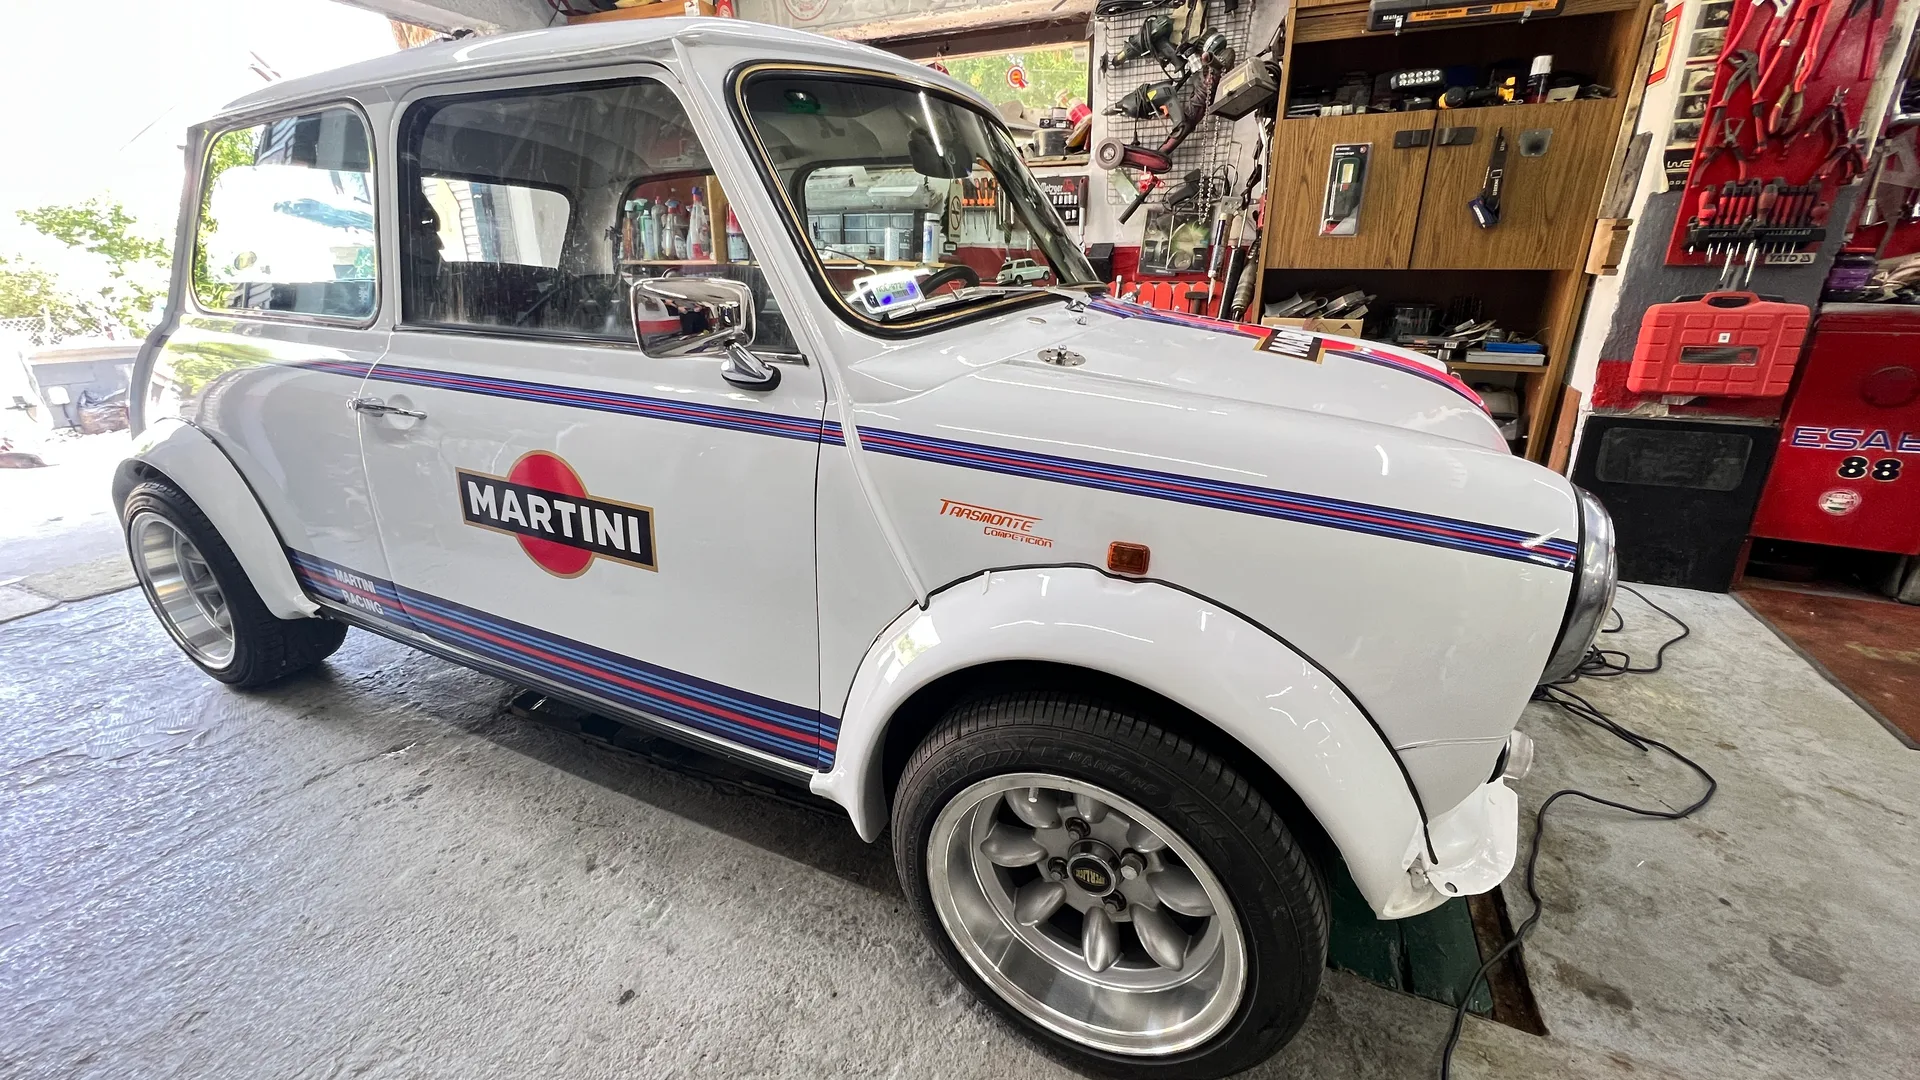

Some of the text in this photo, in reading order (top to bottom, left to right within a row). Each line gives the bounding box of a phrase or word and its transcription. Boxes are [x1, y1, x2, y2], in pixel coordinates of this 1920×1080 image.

[1768, 254, 1798, 263] YATO
[1836, 455, 1904, 482] 88
[467, 481, 641, 554] MARTINI
[940, 498, 1043, 532] TRASMONTE
[334, 568, 377, 594] MARTINI
[341, 589, 384, 615] RACING
